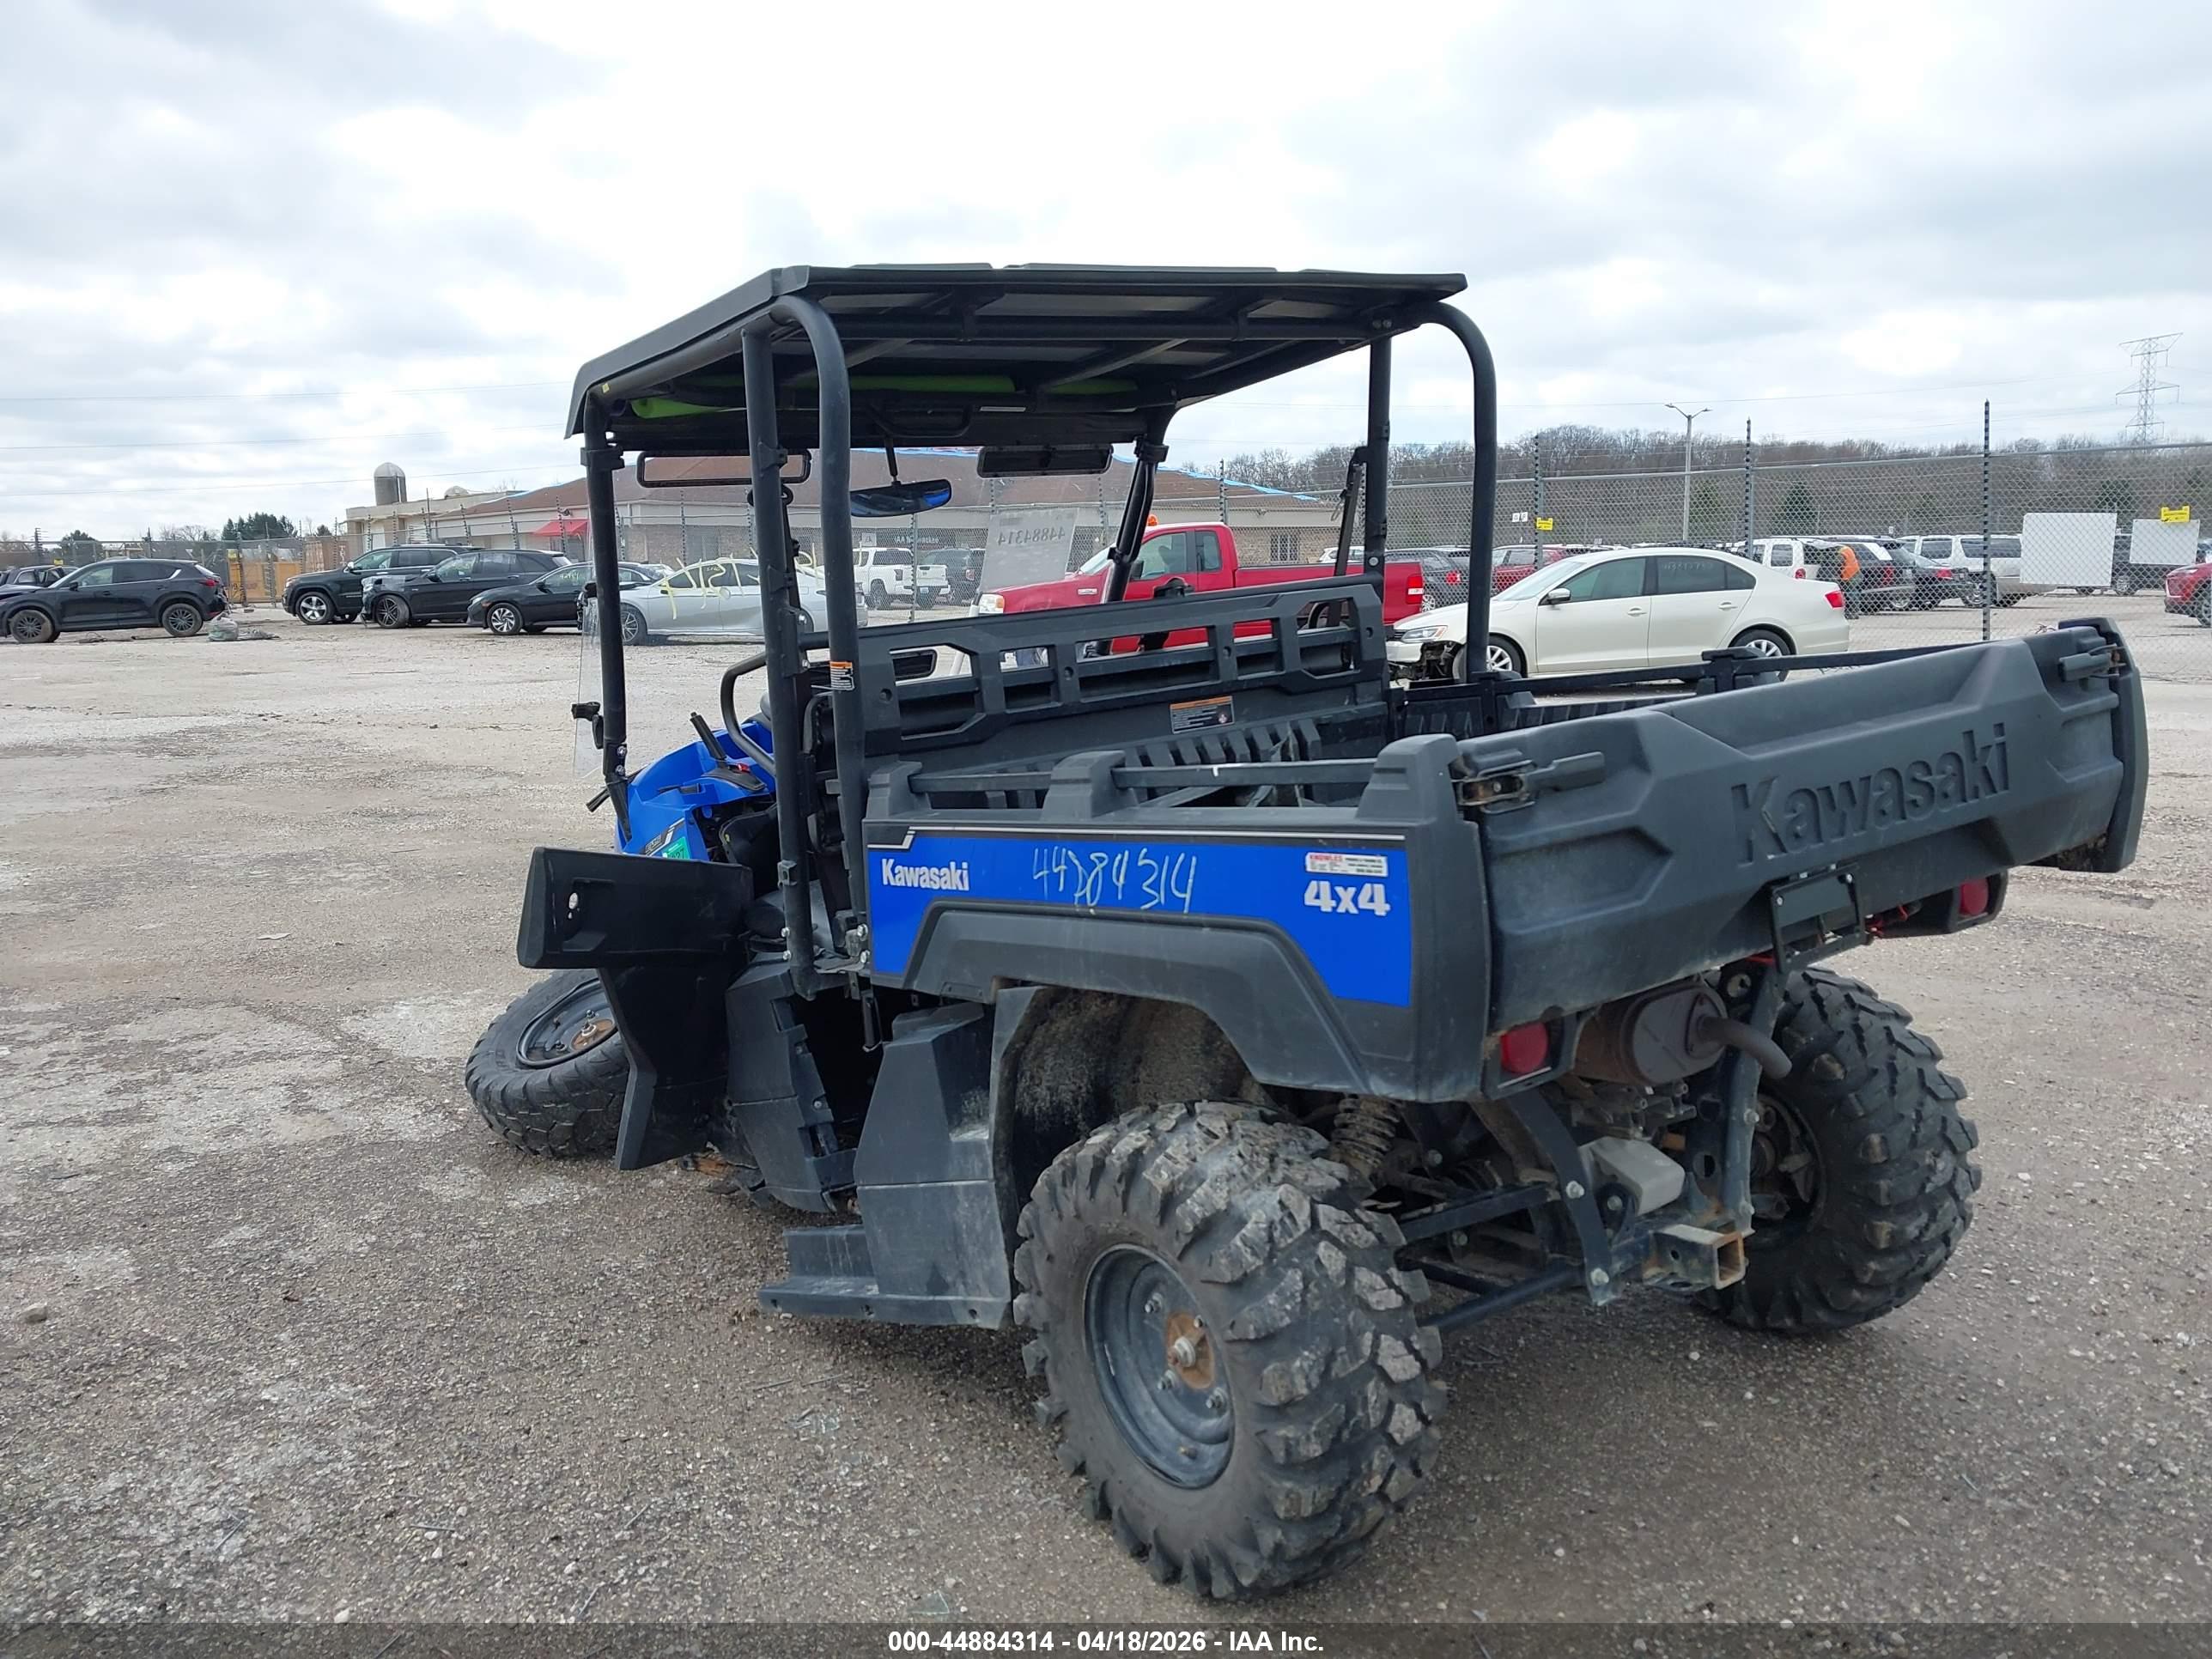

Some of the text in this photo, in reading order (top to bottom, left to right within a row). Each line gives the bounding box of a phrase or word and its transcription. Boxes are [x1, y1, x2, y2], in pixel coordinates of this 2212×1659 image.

[1730, 721, 2010, 868] Kawasaki
[881, 858, 970, 891] Kawasaki
[1304, 879, 1391, 917] 4x4
